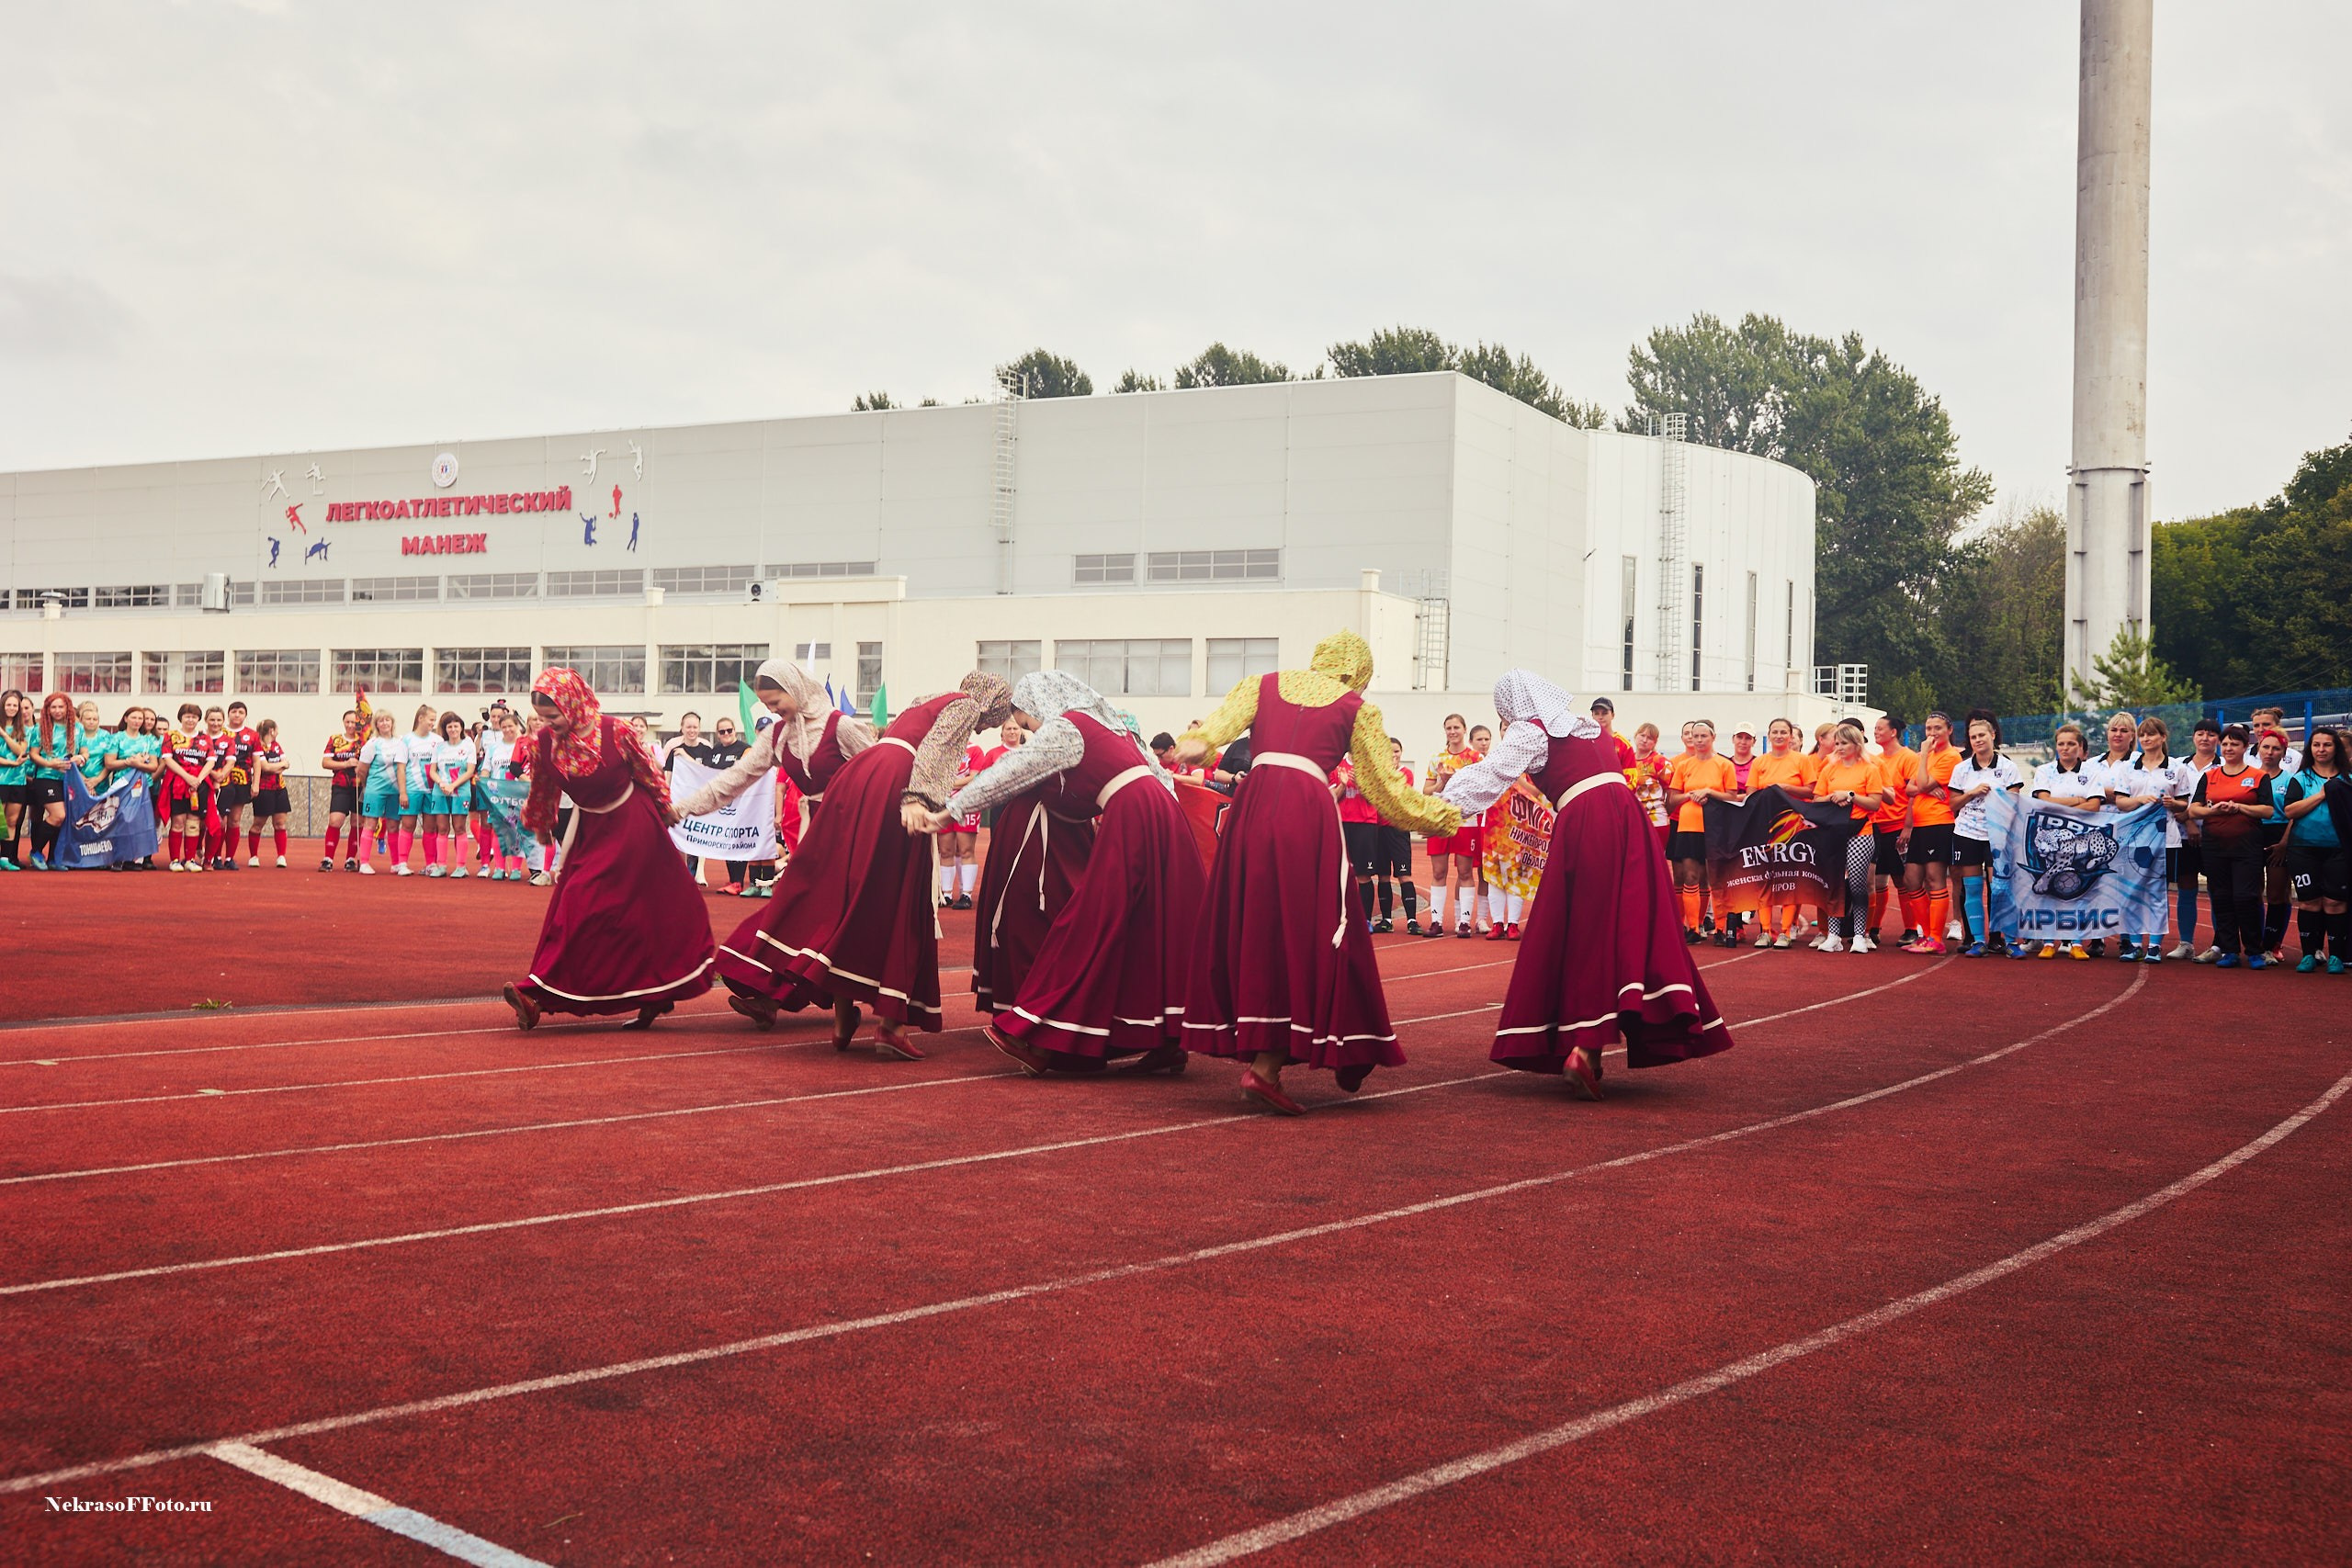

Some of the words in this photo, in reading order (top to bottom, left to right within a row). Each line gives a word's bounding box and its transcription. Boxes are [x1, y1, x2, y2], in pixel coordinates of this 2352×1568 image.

[325, 486, 571, 522] ЛЕГКОАТЛЕТИЧЕСКИЙ
[401, 533, 487, 555] МАНЕЖ
[683, 818, 723, 836] ЦЕНТР
[724, 826, 760, 839] СПОРТА
[965, 814, 976, 825] 15
[79, 840, 113, 856] ТОНШАЕВО
[2295, 874, 2312, 887] 20
[2018, 908, 2120, 931] ИРБИС
